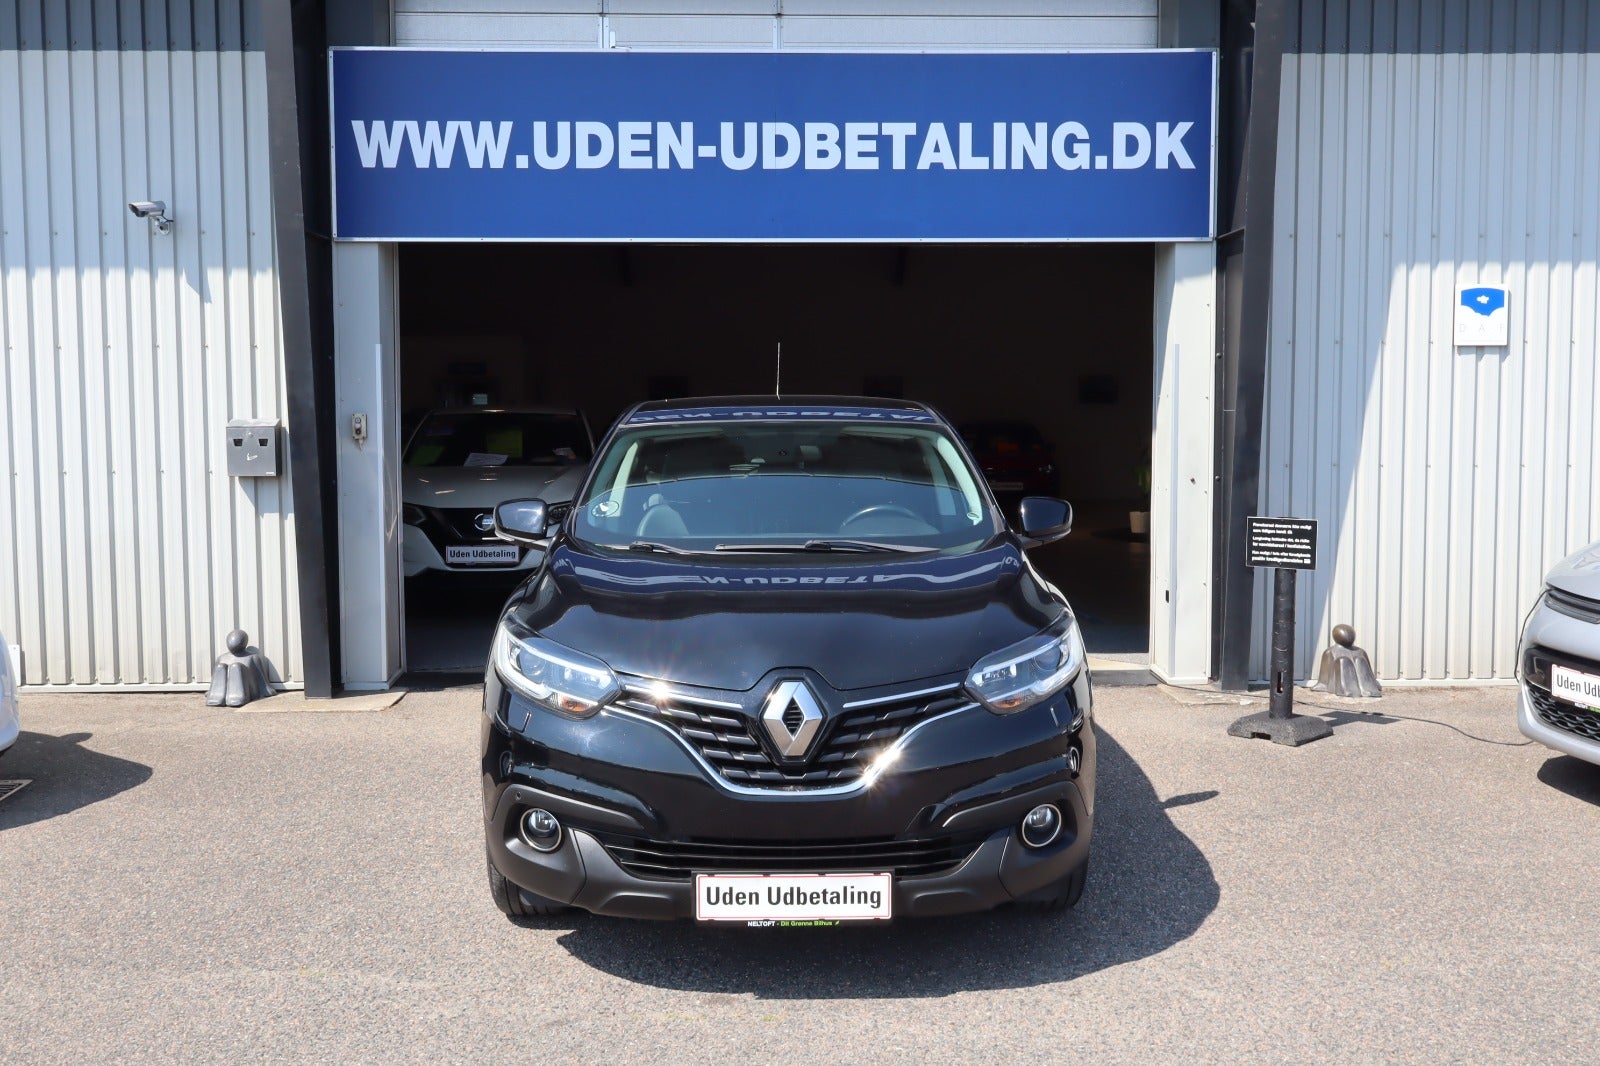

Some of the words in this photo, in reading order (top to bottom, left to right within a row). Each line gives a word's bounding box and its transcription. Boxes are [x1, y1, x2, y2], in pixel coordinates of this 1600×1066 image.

[351, 120, 1196, 170] WWW.UDEN-UDBETALING.DK
[450, 550, 470, 558] Uden
[473, 550, 516, 559] Udbetaling
[1556, 674, 1581, 693] Uden
[706, 886, 760, 905] Uden
[767, 885, 882, 909] Udbetaling
